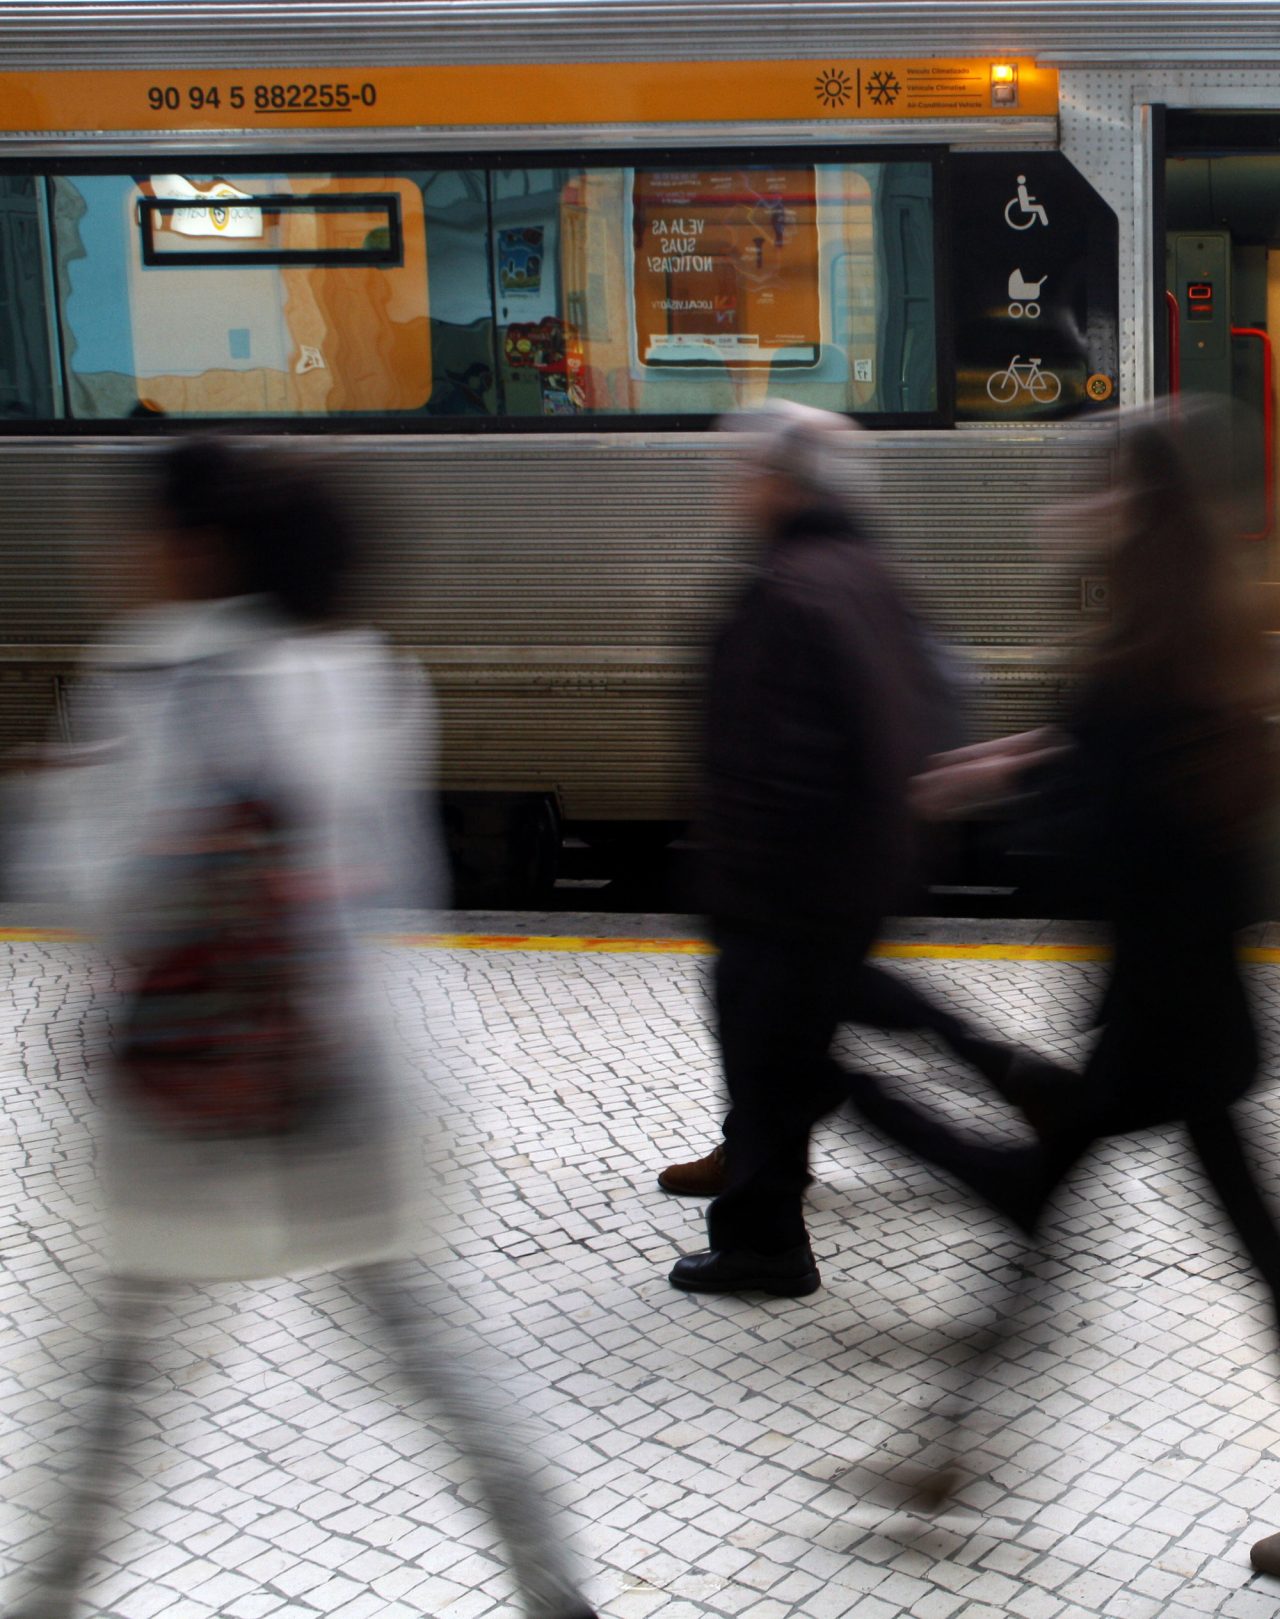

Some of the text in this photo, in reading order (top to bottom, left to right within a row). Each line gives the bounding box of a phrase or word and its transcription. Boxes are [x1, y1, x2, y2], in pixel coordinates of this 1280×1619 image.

[148, 83, 377, 110] 90 94 5 882255-0
